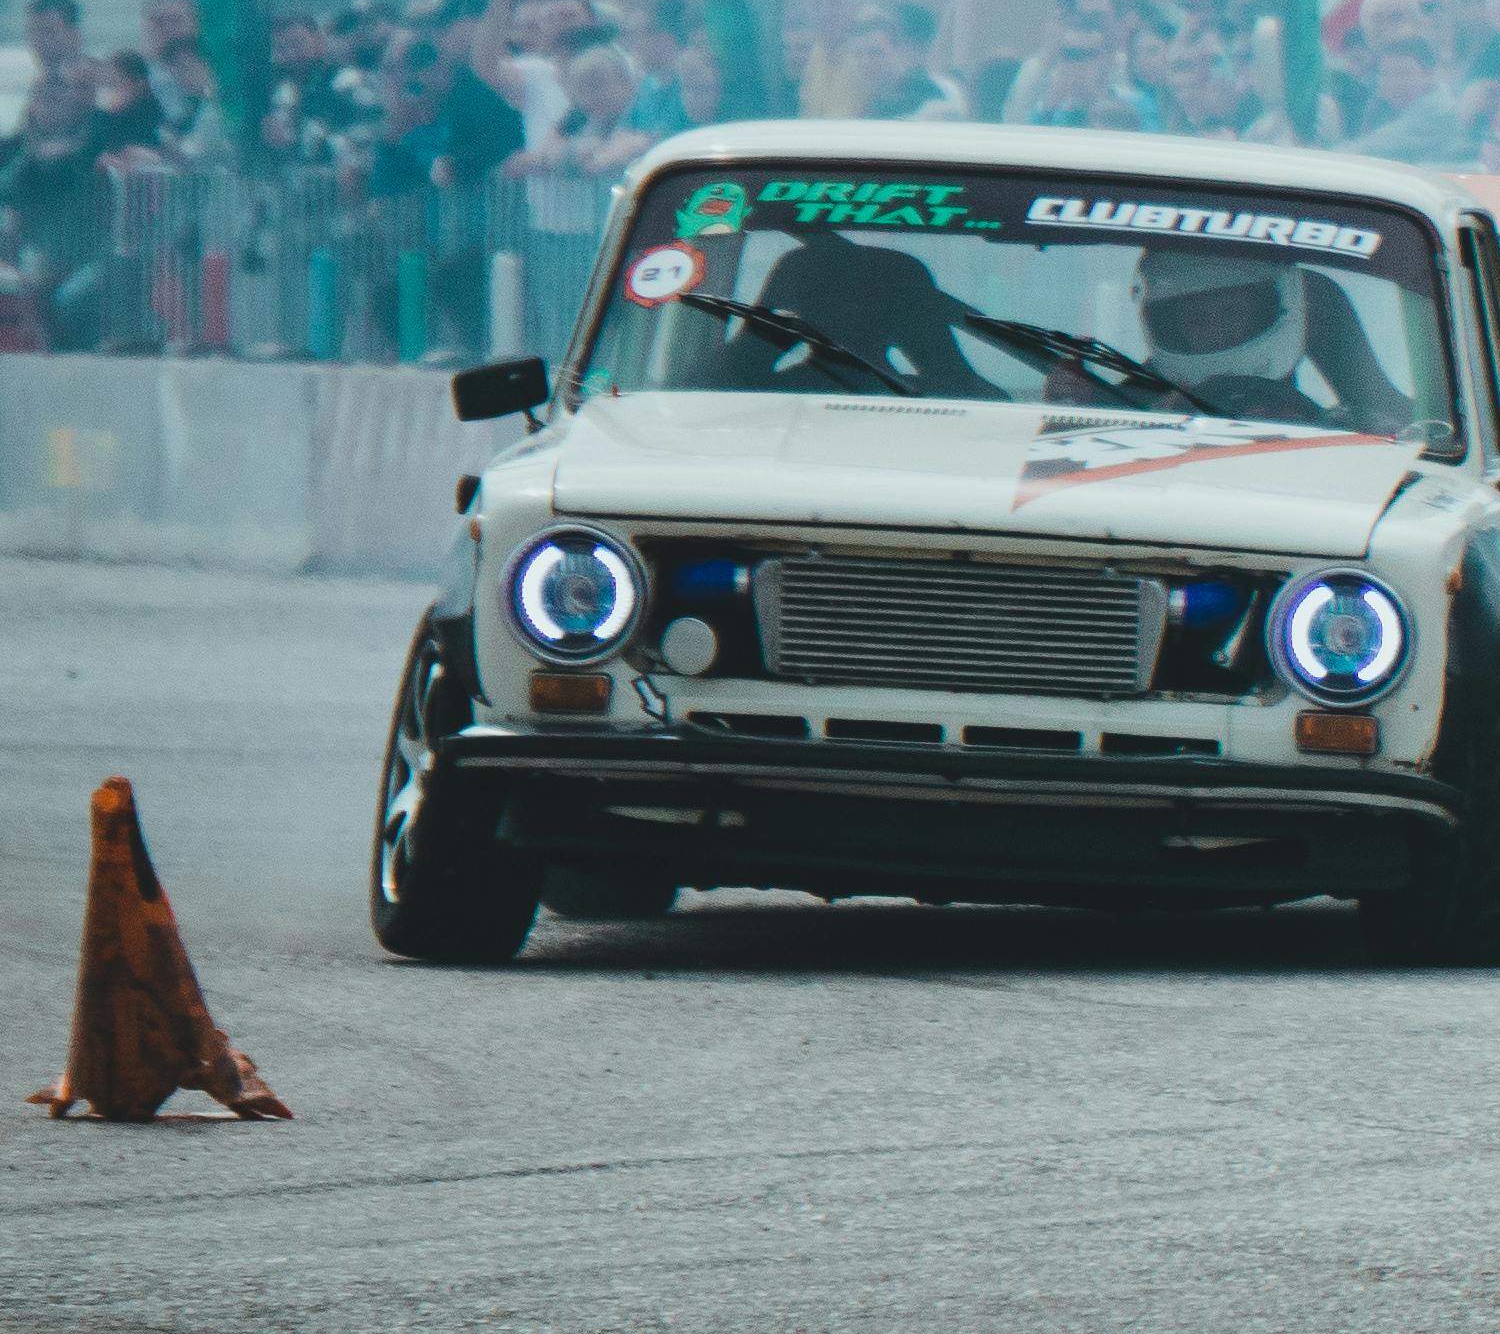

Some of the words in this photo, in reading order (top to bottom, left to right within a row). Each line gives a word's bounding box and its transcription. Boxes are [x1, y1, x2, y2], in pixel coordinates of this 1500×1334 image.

[757, 180, 965, 206] DRIFT
[1026, 197, 1384, 257] CLUBTURBO
[642, 265, 682, 282] 21
